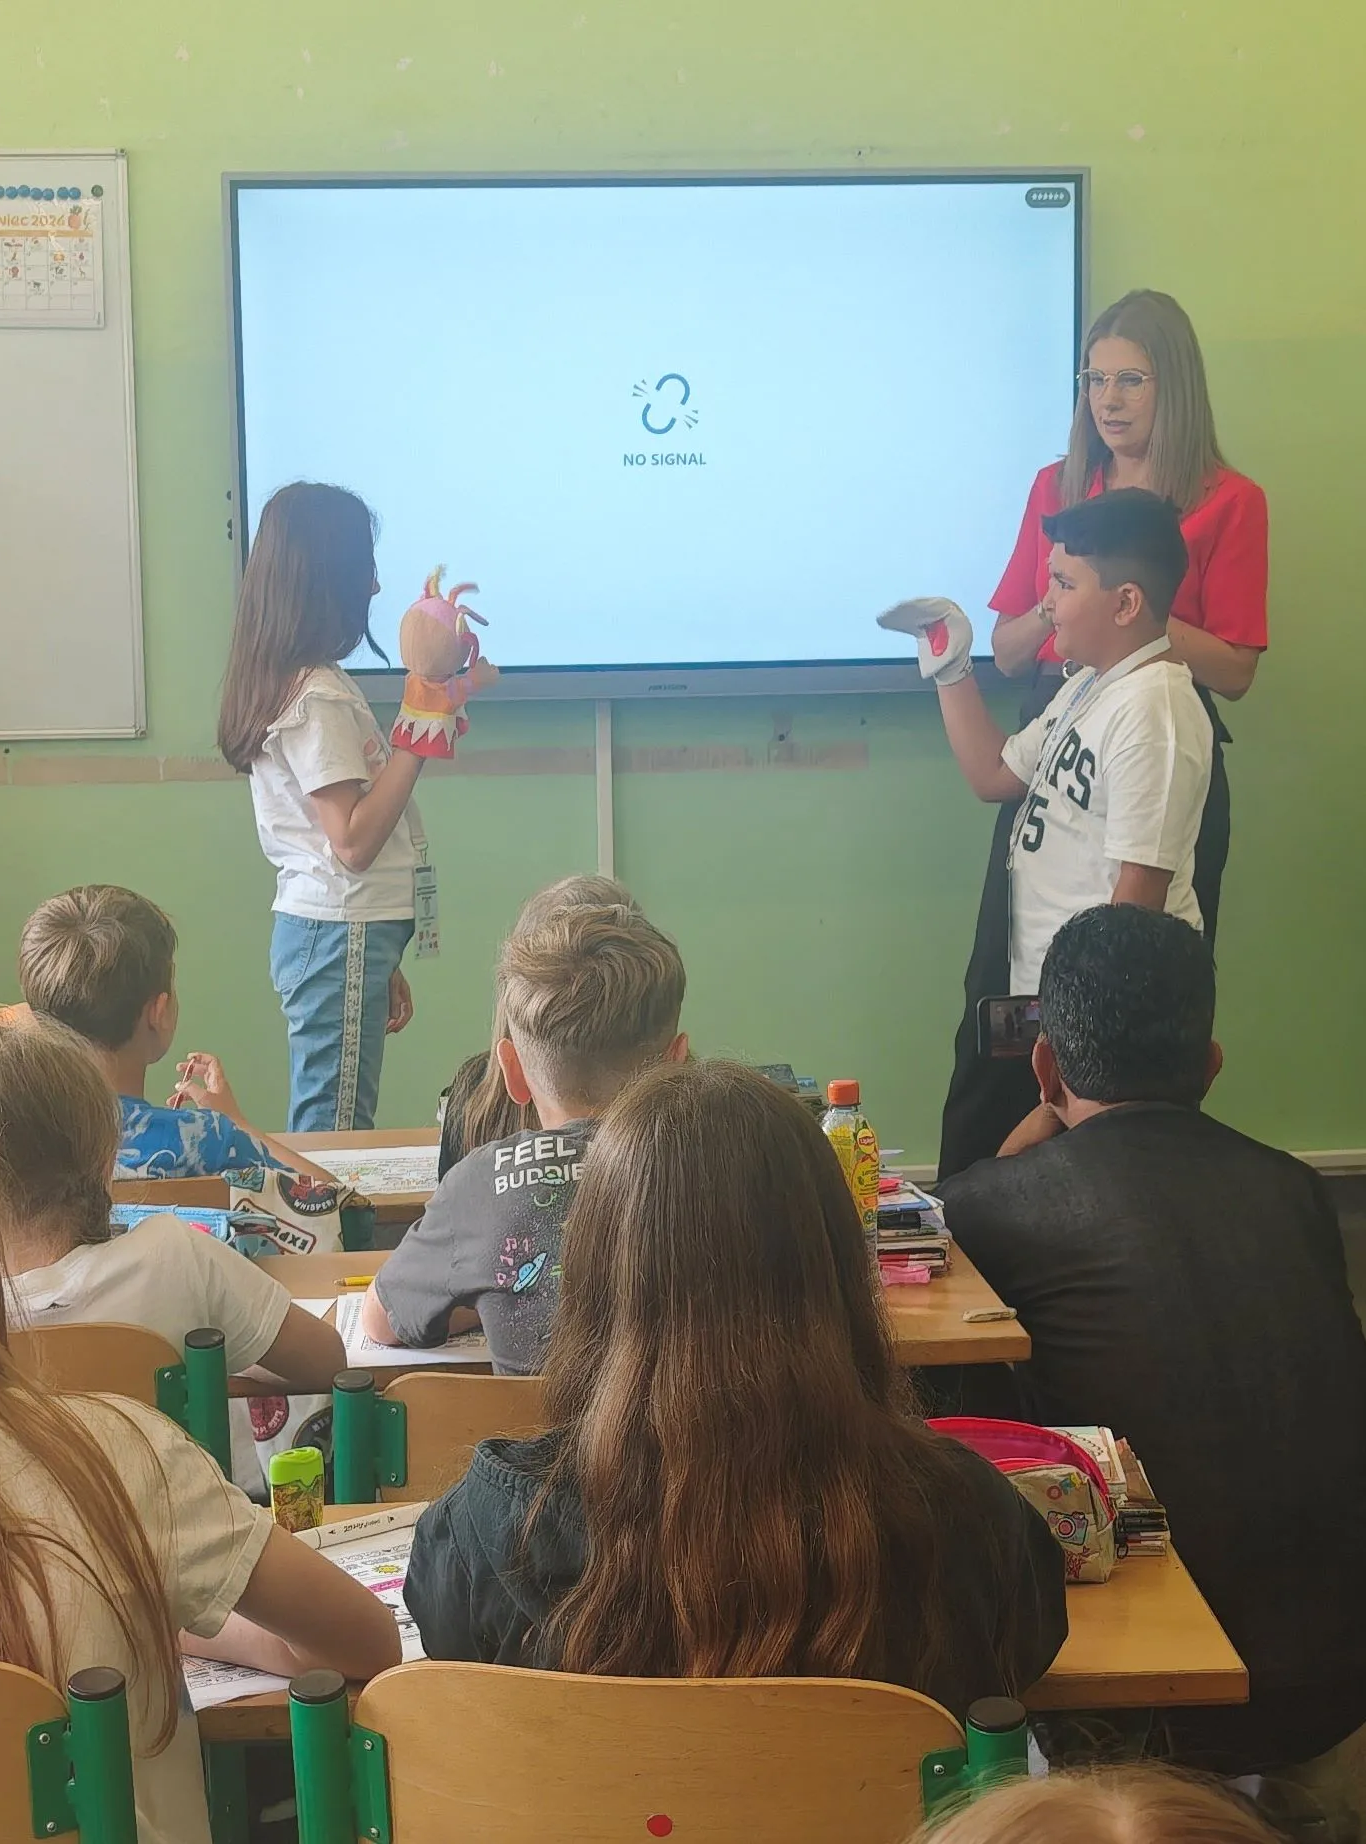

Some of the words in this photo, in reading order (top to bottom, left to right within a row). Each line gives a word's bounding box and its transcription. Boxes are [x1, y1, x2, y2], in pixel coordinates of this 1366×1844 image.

[31, 214, 65, 227] 2026
[623, 452, 646, 467] NO
[651, 452, 707, 467] SIGNAL
[494, 1136, 577, 1172] FEEL
[494, 1162, 586, 1196] BUDDIE
